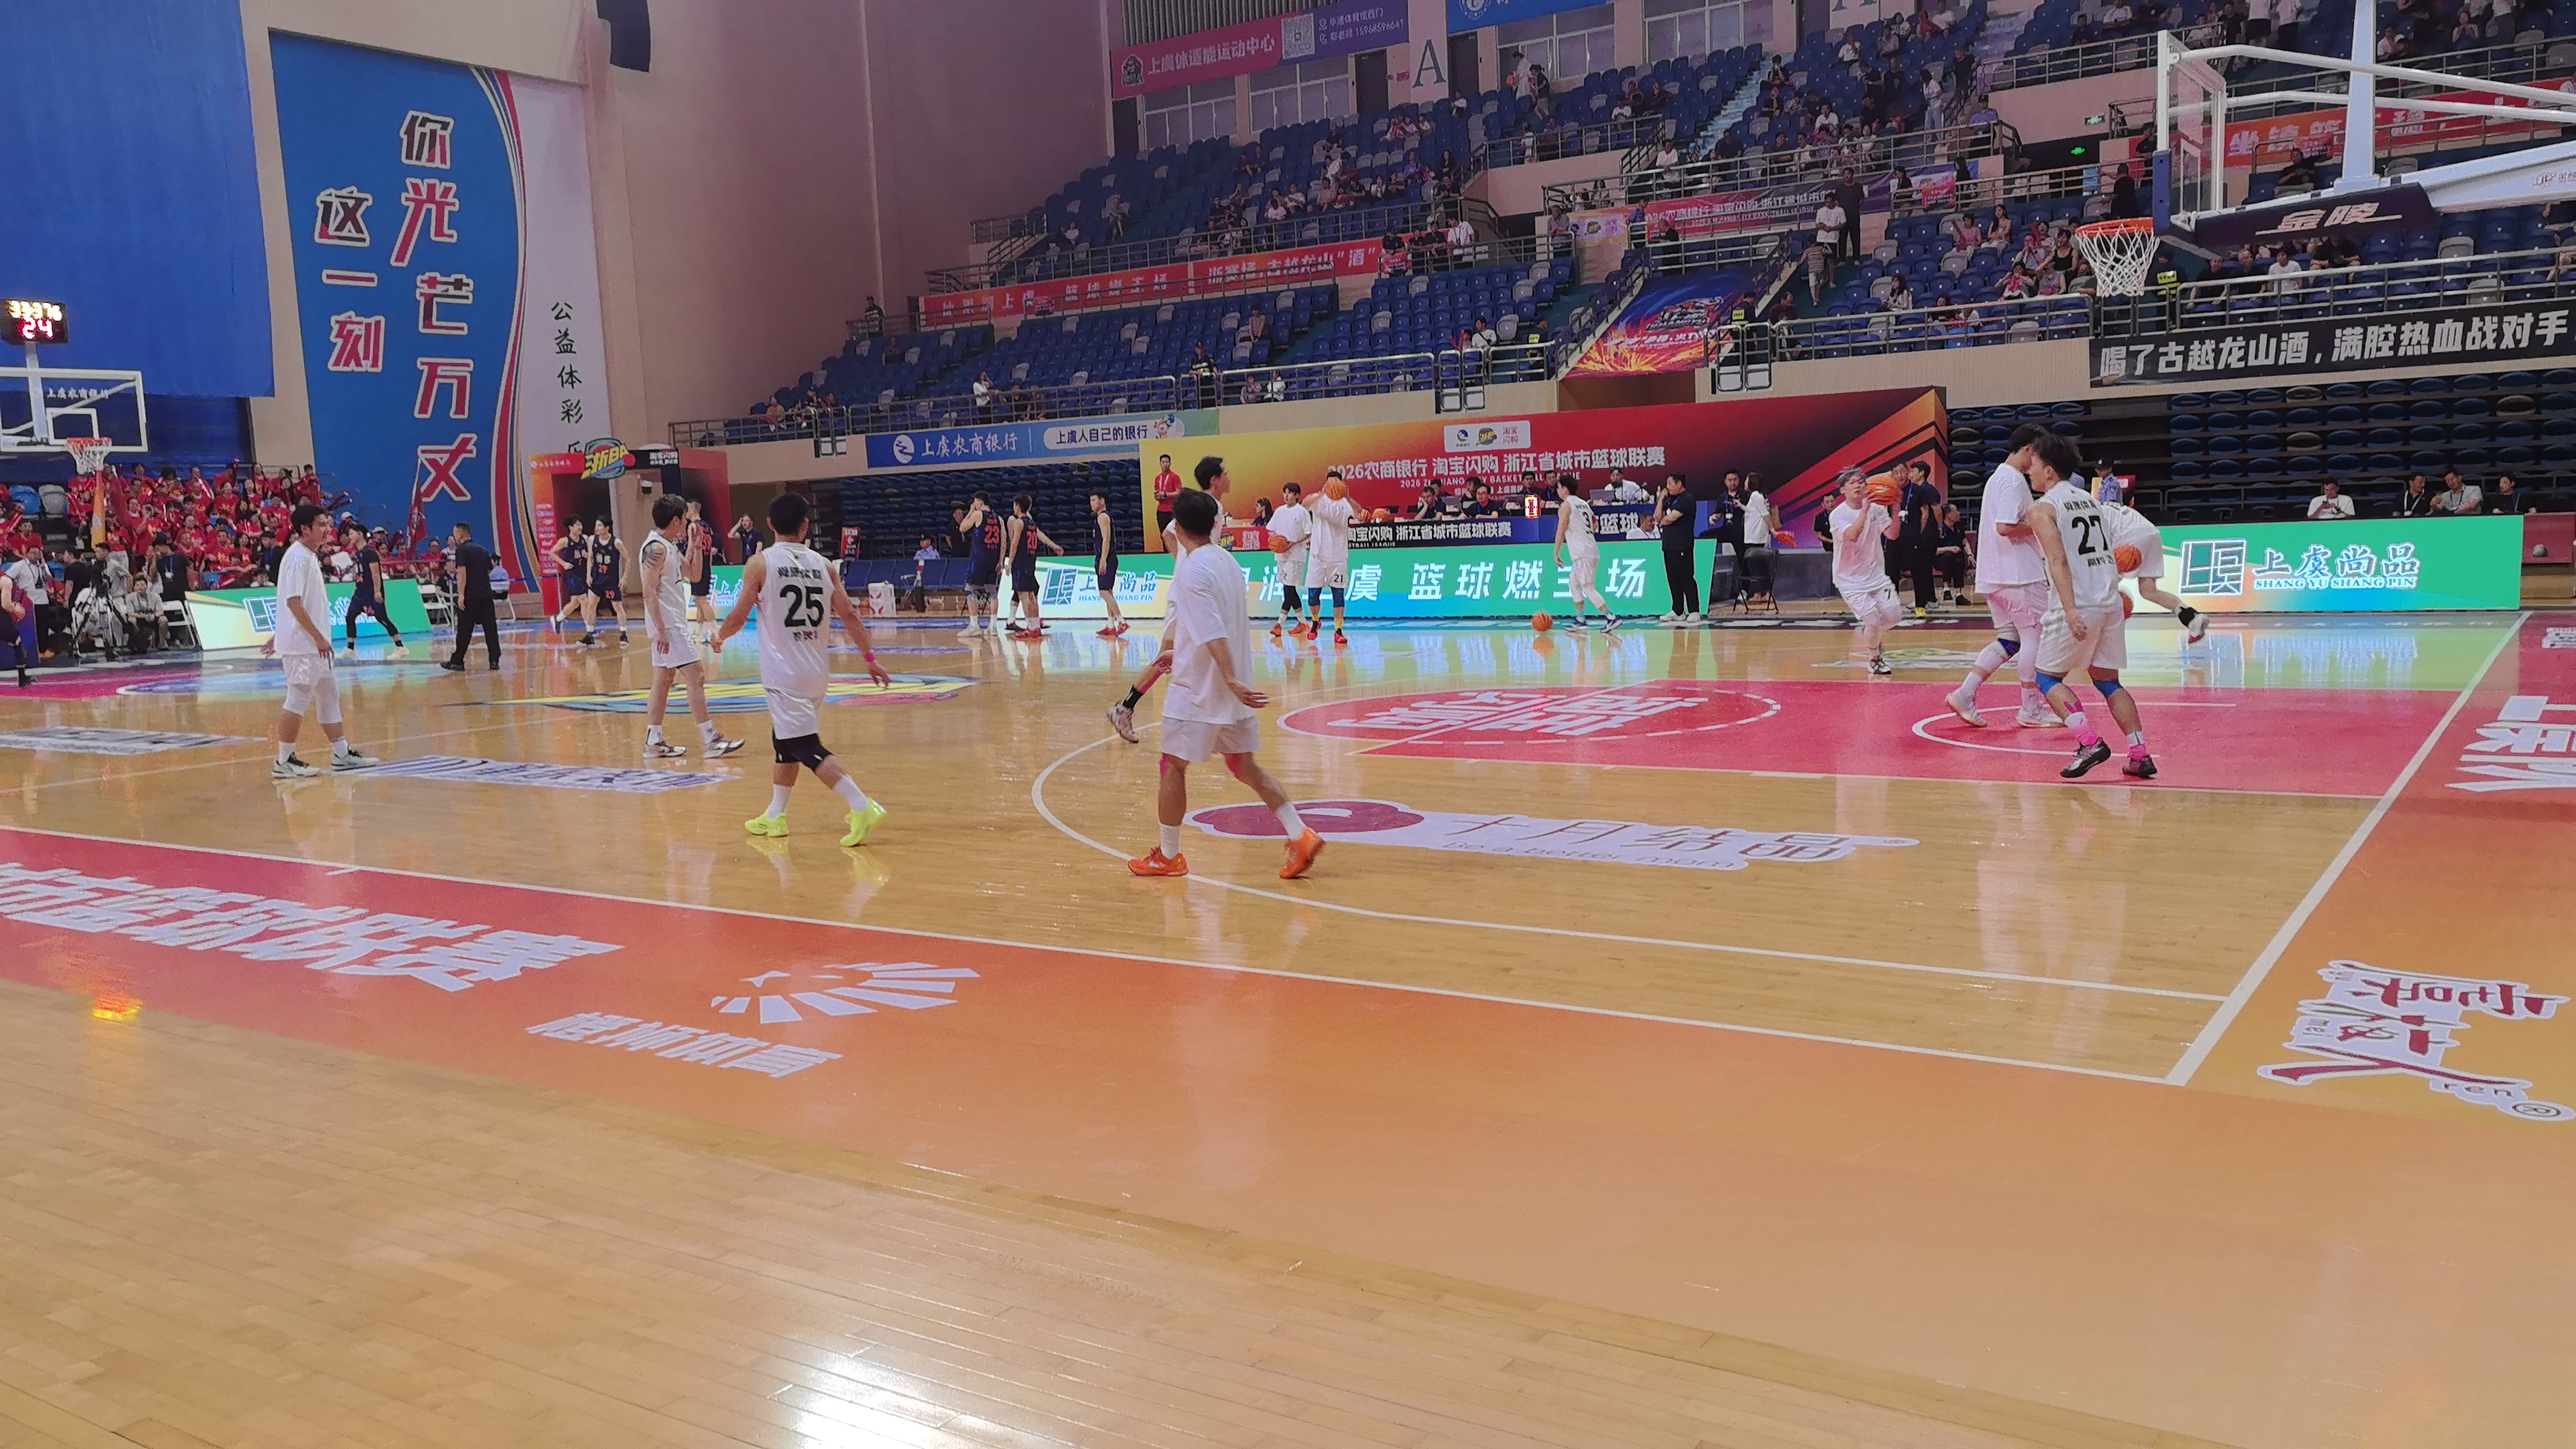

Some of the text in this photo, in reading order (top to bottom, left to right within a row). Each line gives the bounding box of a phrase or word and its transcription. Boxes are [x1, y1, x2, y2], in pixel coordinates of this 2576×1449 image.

[1412, 38, 1446, 88] A
[315, 186, 386, 373] 这一刻
[390, 110, 478, 502] 你光芒万丈
[22, 317, 54, 339] 24
[921, 424, 1148, 458] 上虞农商银行 上虞人自己的银行
[1503, 426, 1519, 435] 淘宝
[1503, 435, 1519, 444] 闪购
[1432, 453, 1500, 476] 淘宝闪购
[1503, 445, 1666, 472] 浙江省城市篮球联赛
[1400, 478, 1421, 488] 2026
[1490, 472, 1544, 484] BASKETLL
[984, 525, 1000, 545] 23
[1396, 521, 1511, 542] 浙江省城市篮球联赛
[2072, 515, 2109, 556] 27
[2253, 542, 2420, 579] 上虞尚品
[1079, 570, 1157, 594] 上尚品
[1334, 574, 1344, 584] 21
[2255, 577, 2416, 589] SHANG YU SHANG PIN
[780, 584, 824, 628] 25
[1140, 593, 1154, 602] PIN
[1445, 816, 1851, 859] 十月结晶
